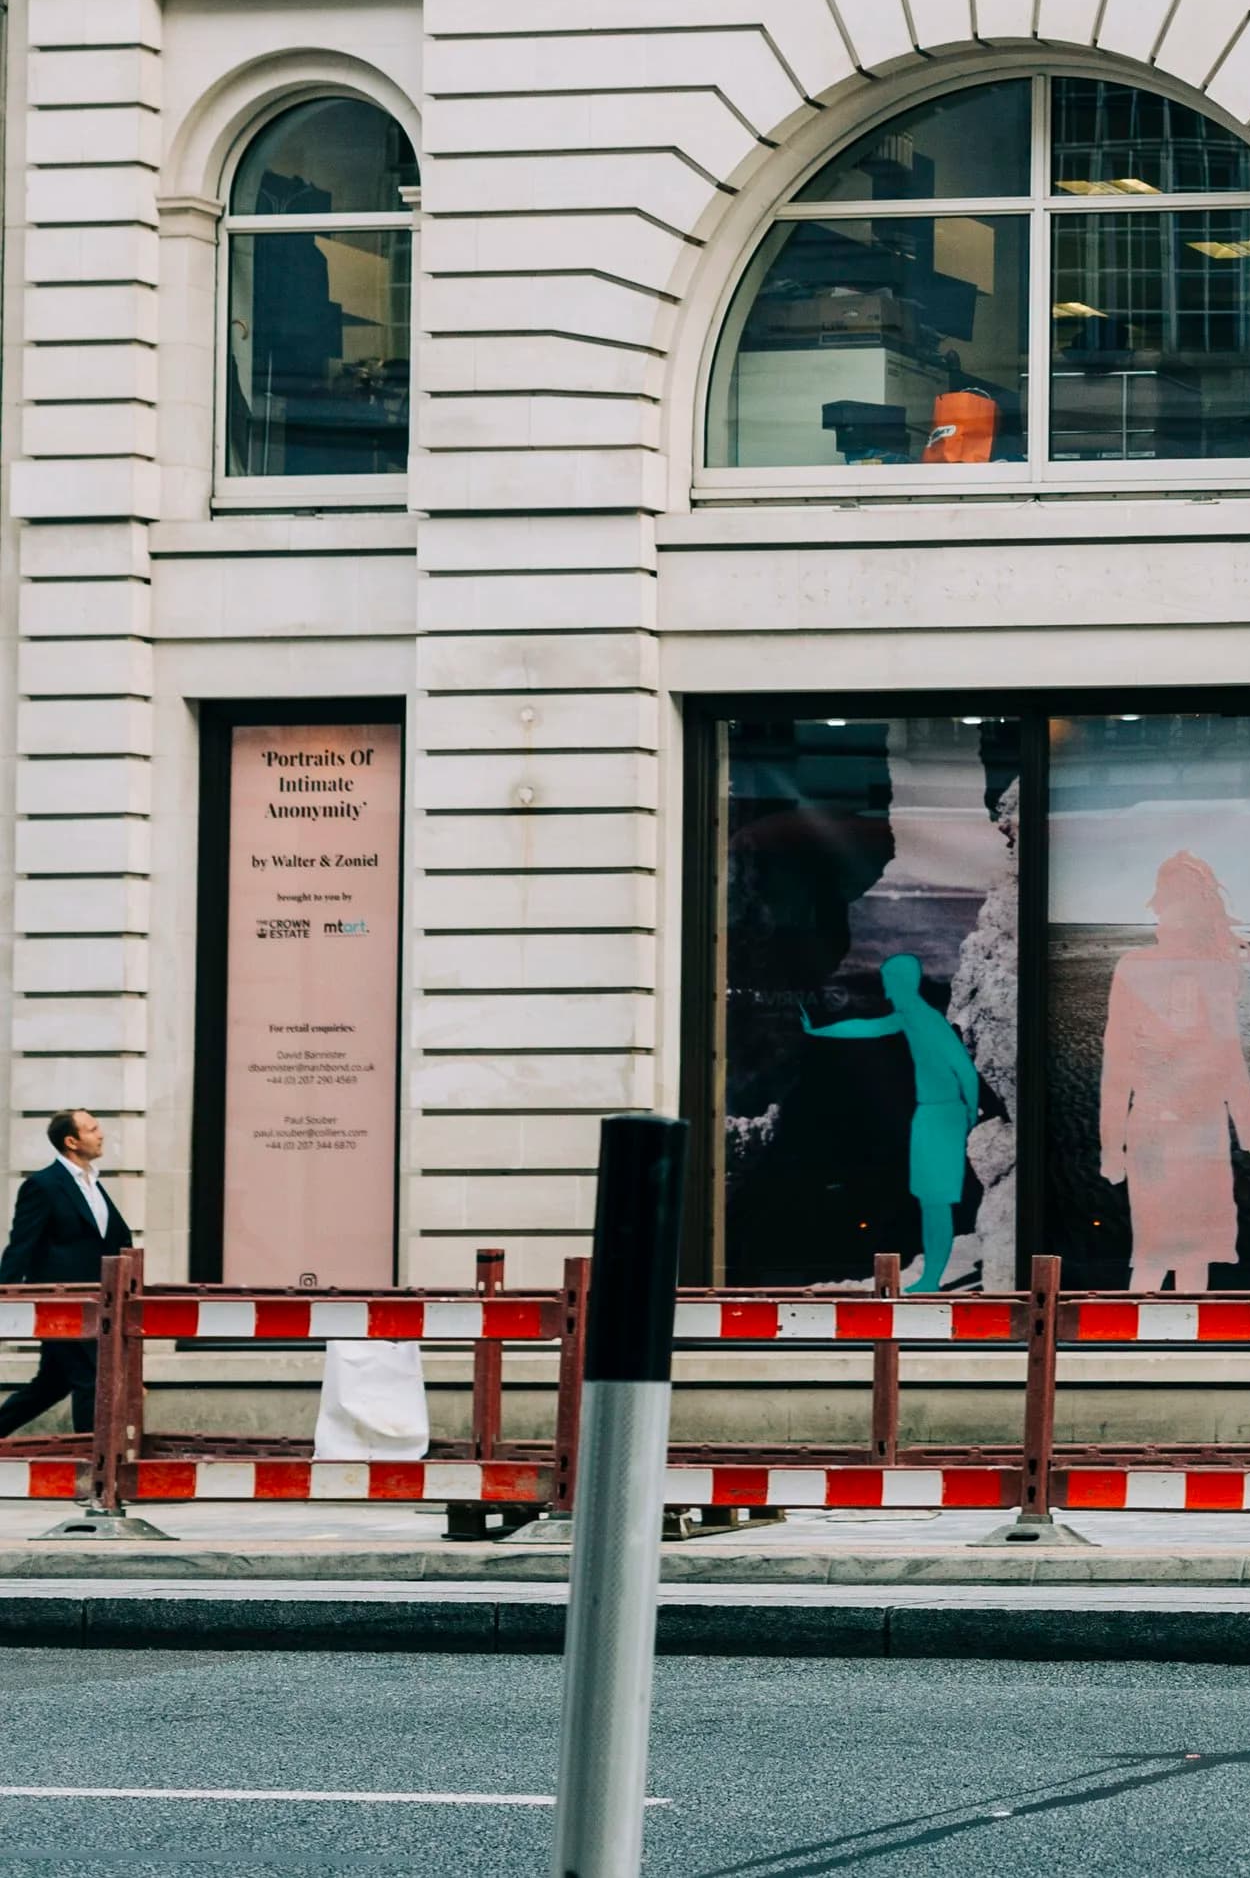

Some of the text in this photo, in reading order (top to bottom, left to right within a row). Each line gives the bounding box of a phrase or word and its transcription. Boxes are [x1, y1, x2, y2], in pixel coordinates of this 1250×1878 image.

[350, 749, 374, 766] Of
[279, 776, 354, 793] Intimate
[252, 854, 378, 871] by Walter & Zoniel
[277, 891, 352, 903] brought to you by
[269, 919, 311, 929] CROWN
[269, 929, 311, 939] ESTATE
[269, 1024, 285, 1033] For
[286, 1023, 309, 1033] retail
[276, 1050, 347, 1060] David Bannister
[284, 1115, 338, 1124] Paul Souber
